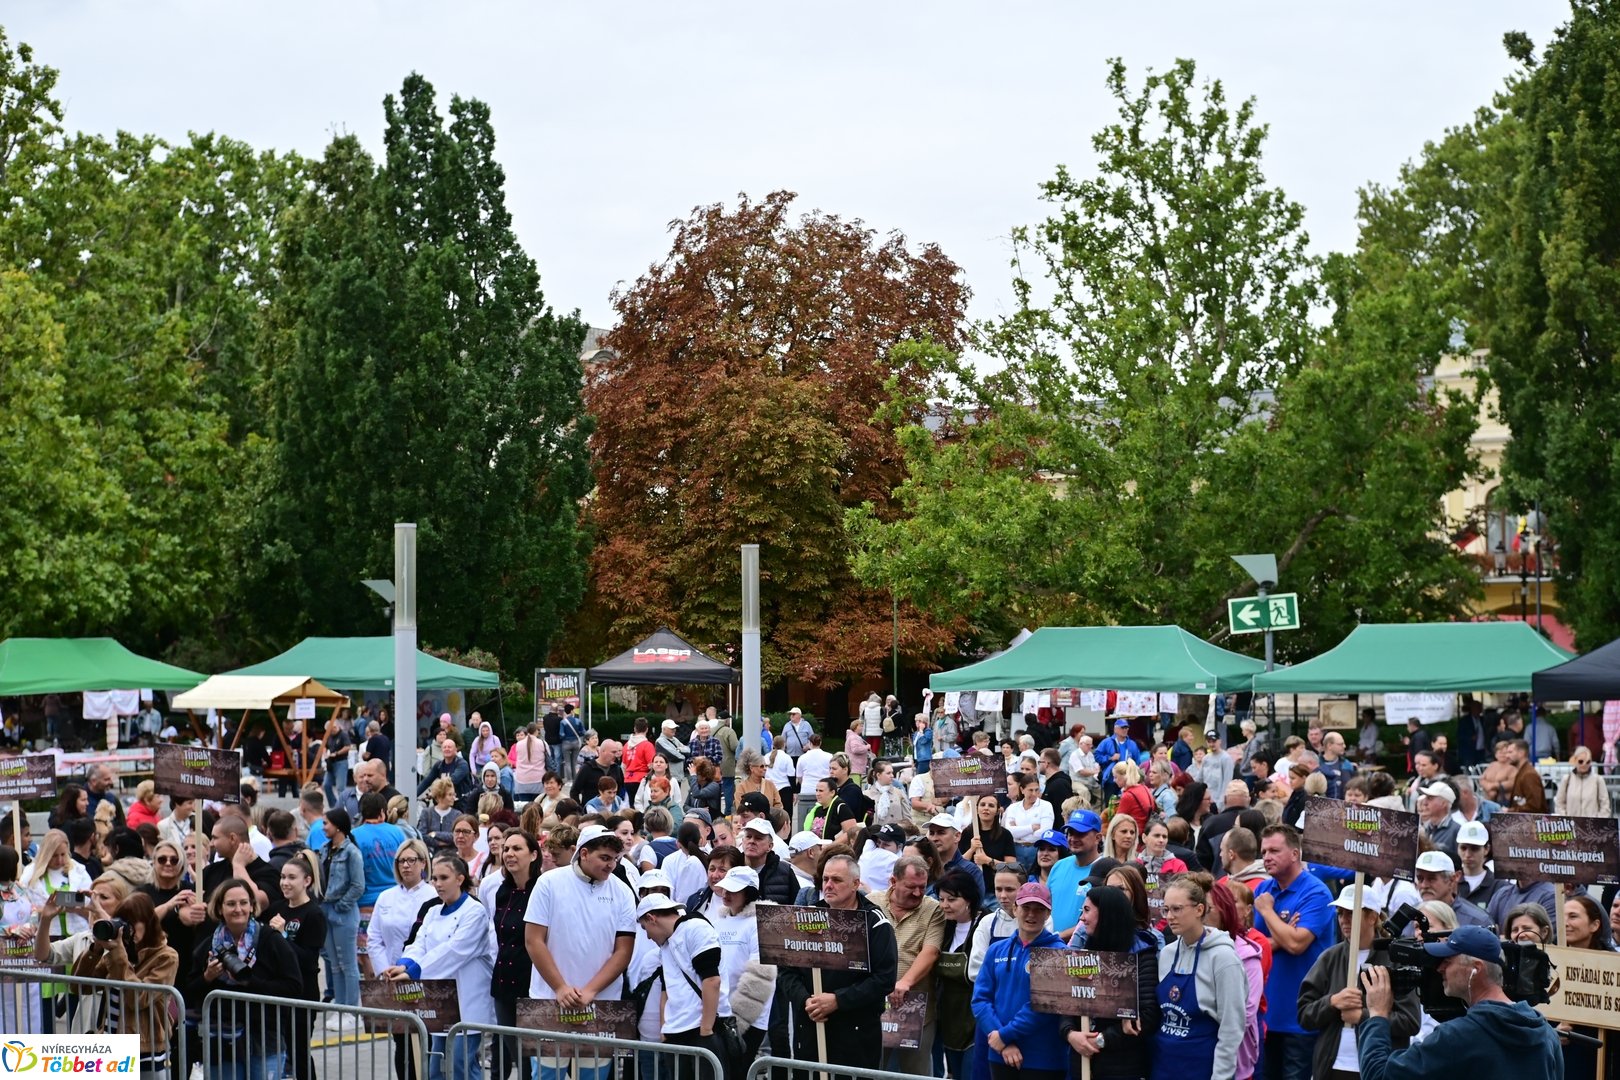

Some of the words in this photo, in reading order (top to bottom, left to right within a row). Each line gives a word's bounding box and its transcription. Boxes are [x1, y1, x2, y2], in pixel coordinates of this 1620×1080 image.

[633, 648, 691, 656] LASER
[180, 773, 193, 784] M71
[194, 775, 215, 787] Bistro
[1345, 806, 1378, 822] Tirpák
[1346, 820, 1378, 831] Fesztivál
[1535, 818, 1572, 834] Tirpák
[1538, 832, 1573, 842] Fesztivál
[1344, 838, 1379, 857] ORGANX
[1509, 846, 1550, 859] Kisvárdai
[1552, 848, 1605, 863] Szakképzési
[1539, 862, 1576, 875] Centrum
[795, 910, 827, 923] Tirpák
[797, 922, 828, 931] Fesztivál
[784, 938, 823, 952] Papricue
[824, 941, 844, 955] BBQ
[1066, 953, 1097, 968] Tirpák
[1068, 966, 1098, 976] Fesztivál
[1565, 964, 1601, 985] KISVÁRDAI
[1602, 970, 1615, 986] SZC
[1071, 985, 1097, 999] NYVSC
[1564, 991, 1602, 1010] TECHNIKUM
[1604, 991, 1612, 1011] ÉS
